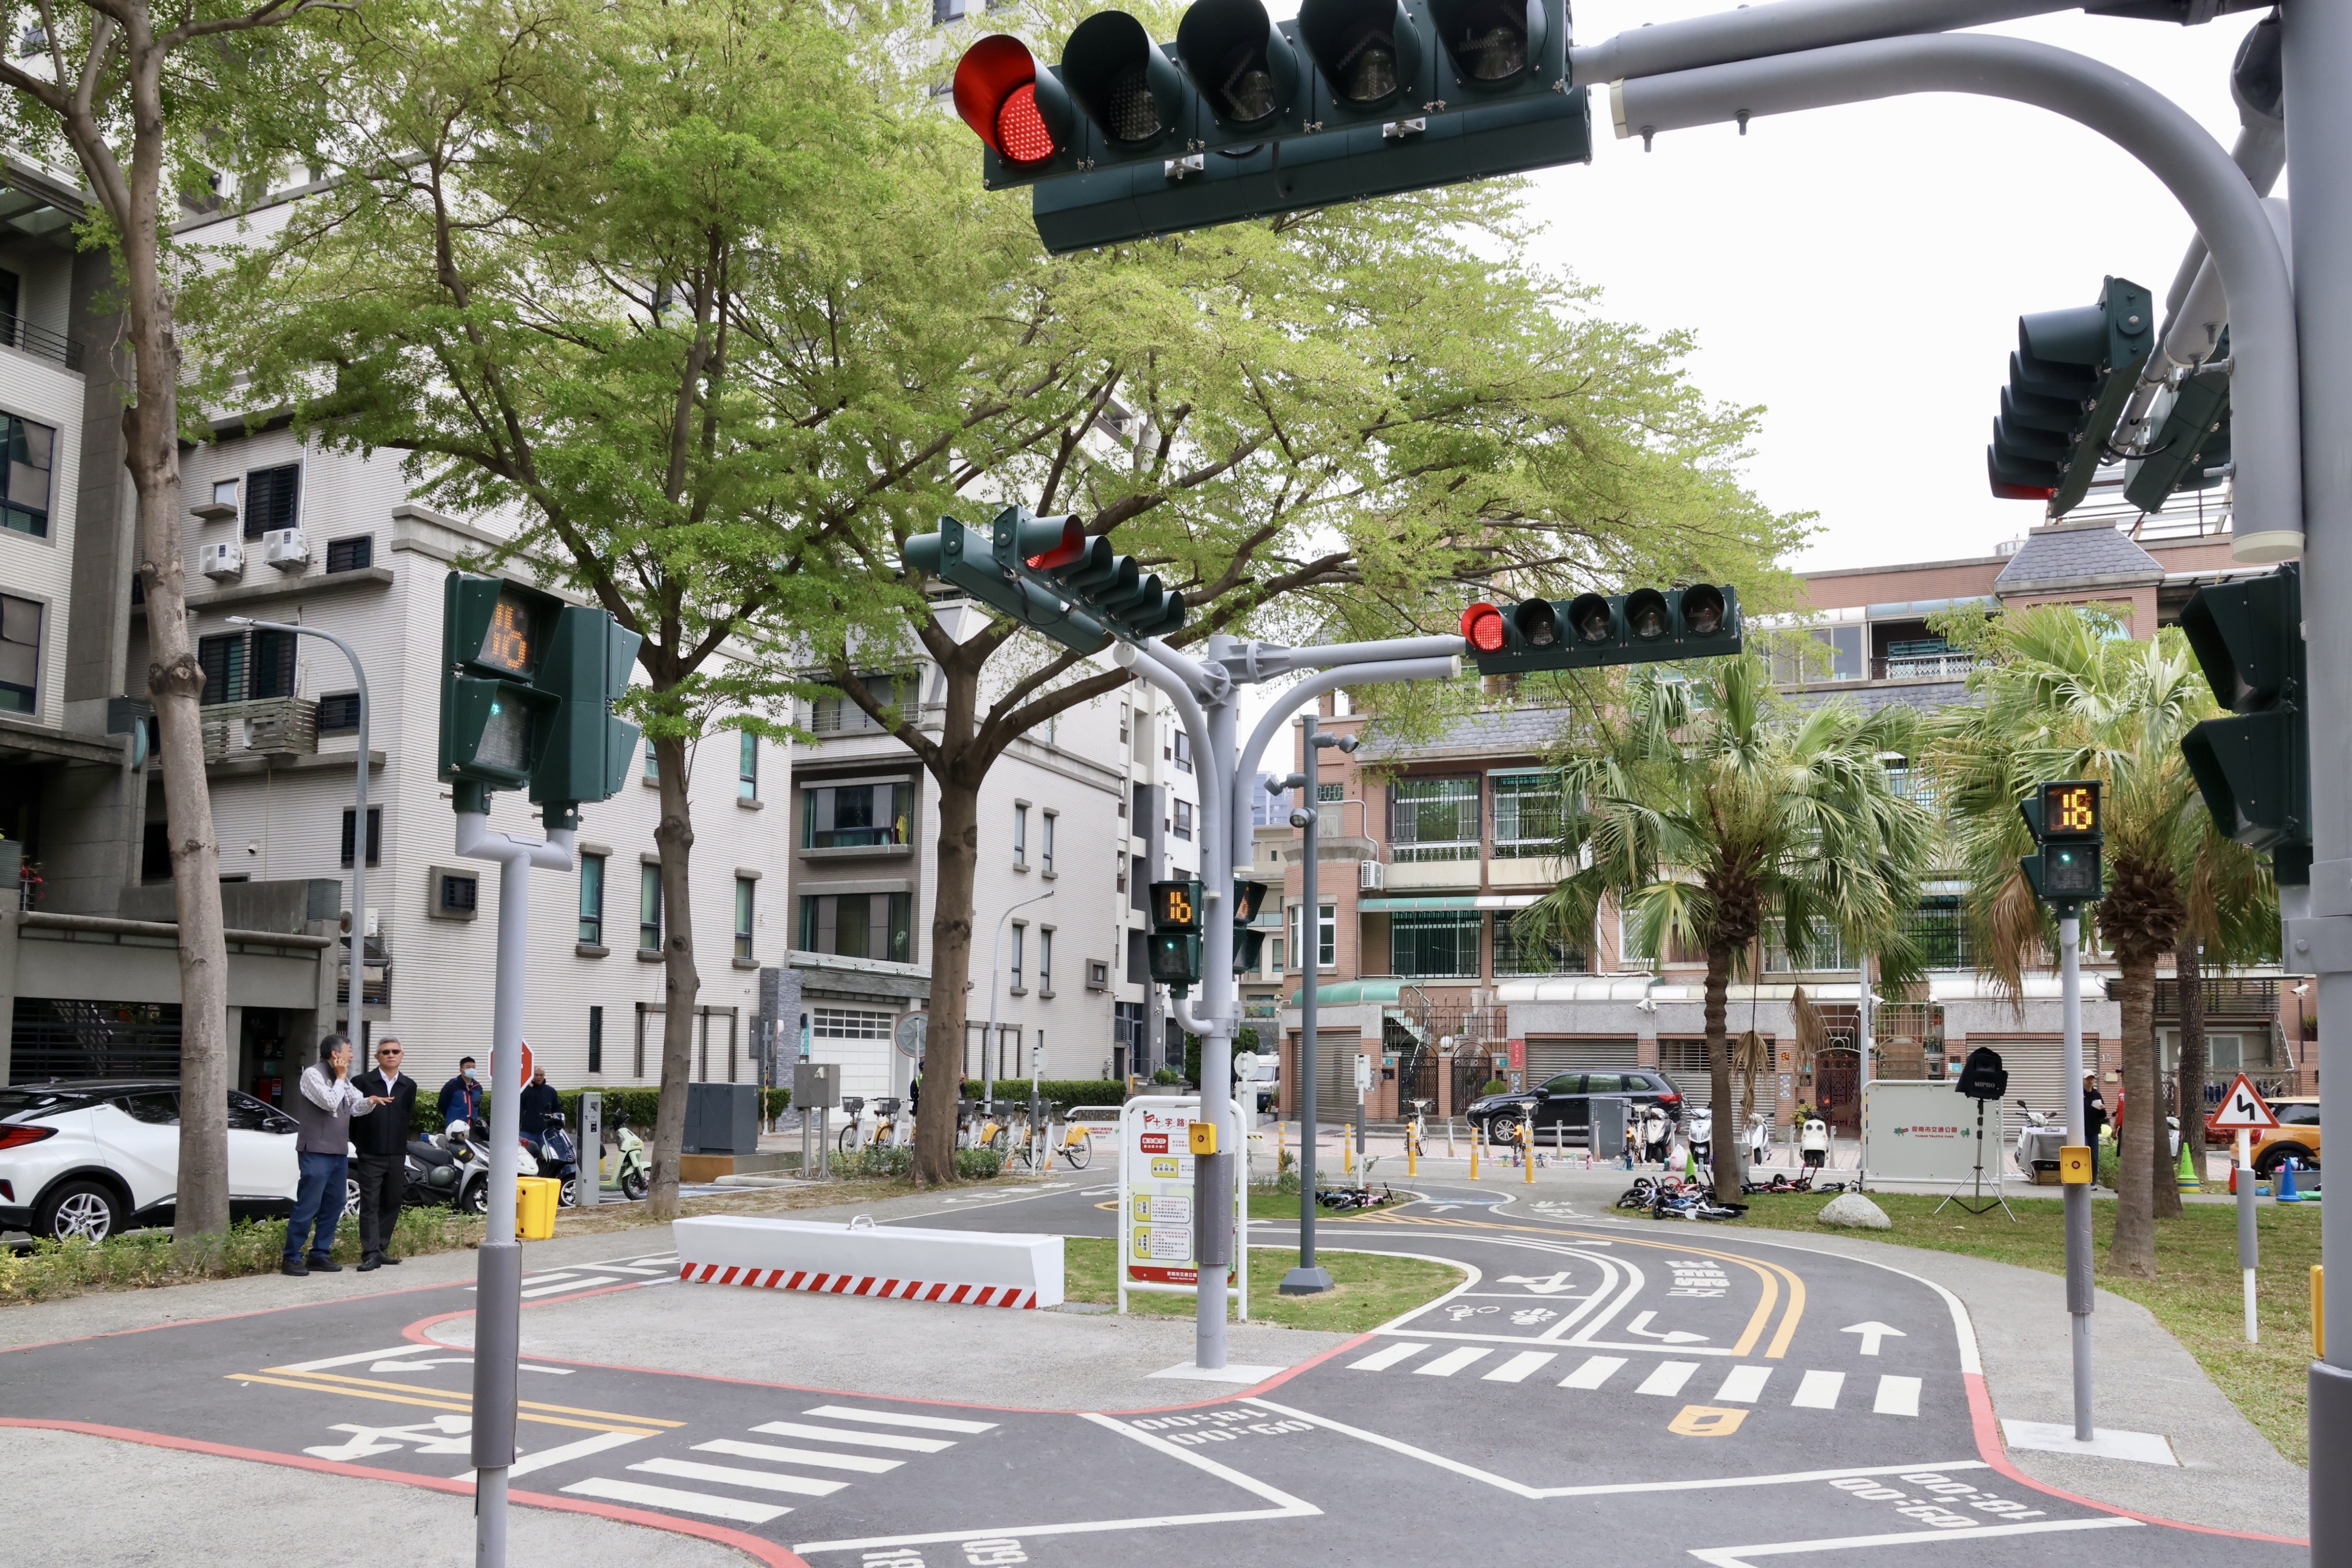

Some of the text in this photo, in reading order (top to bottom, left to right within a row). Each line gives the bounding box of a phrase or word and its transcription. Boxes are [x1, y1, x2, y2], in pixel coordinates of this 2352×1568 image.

[2063, 789, 2092, 829] 16
[2101, 1054, 2112, 1062] 15
[1829, 1478, 1980, 1528] 09:00
